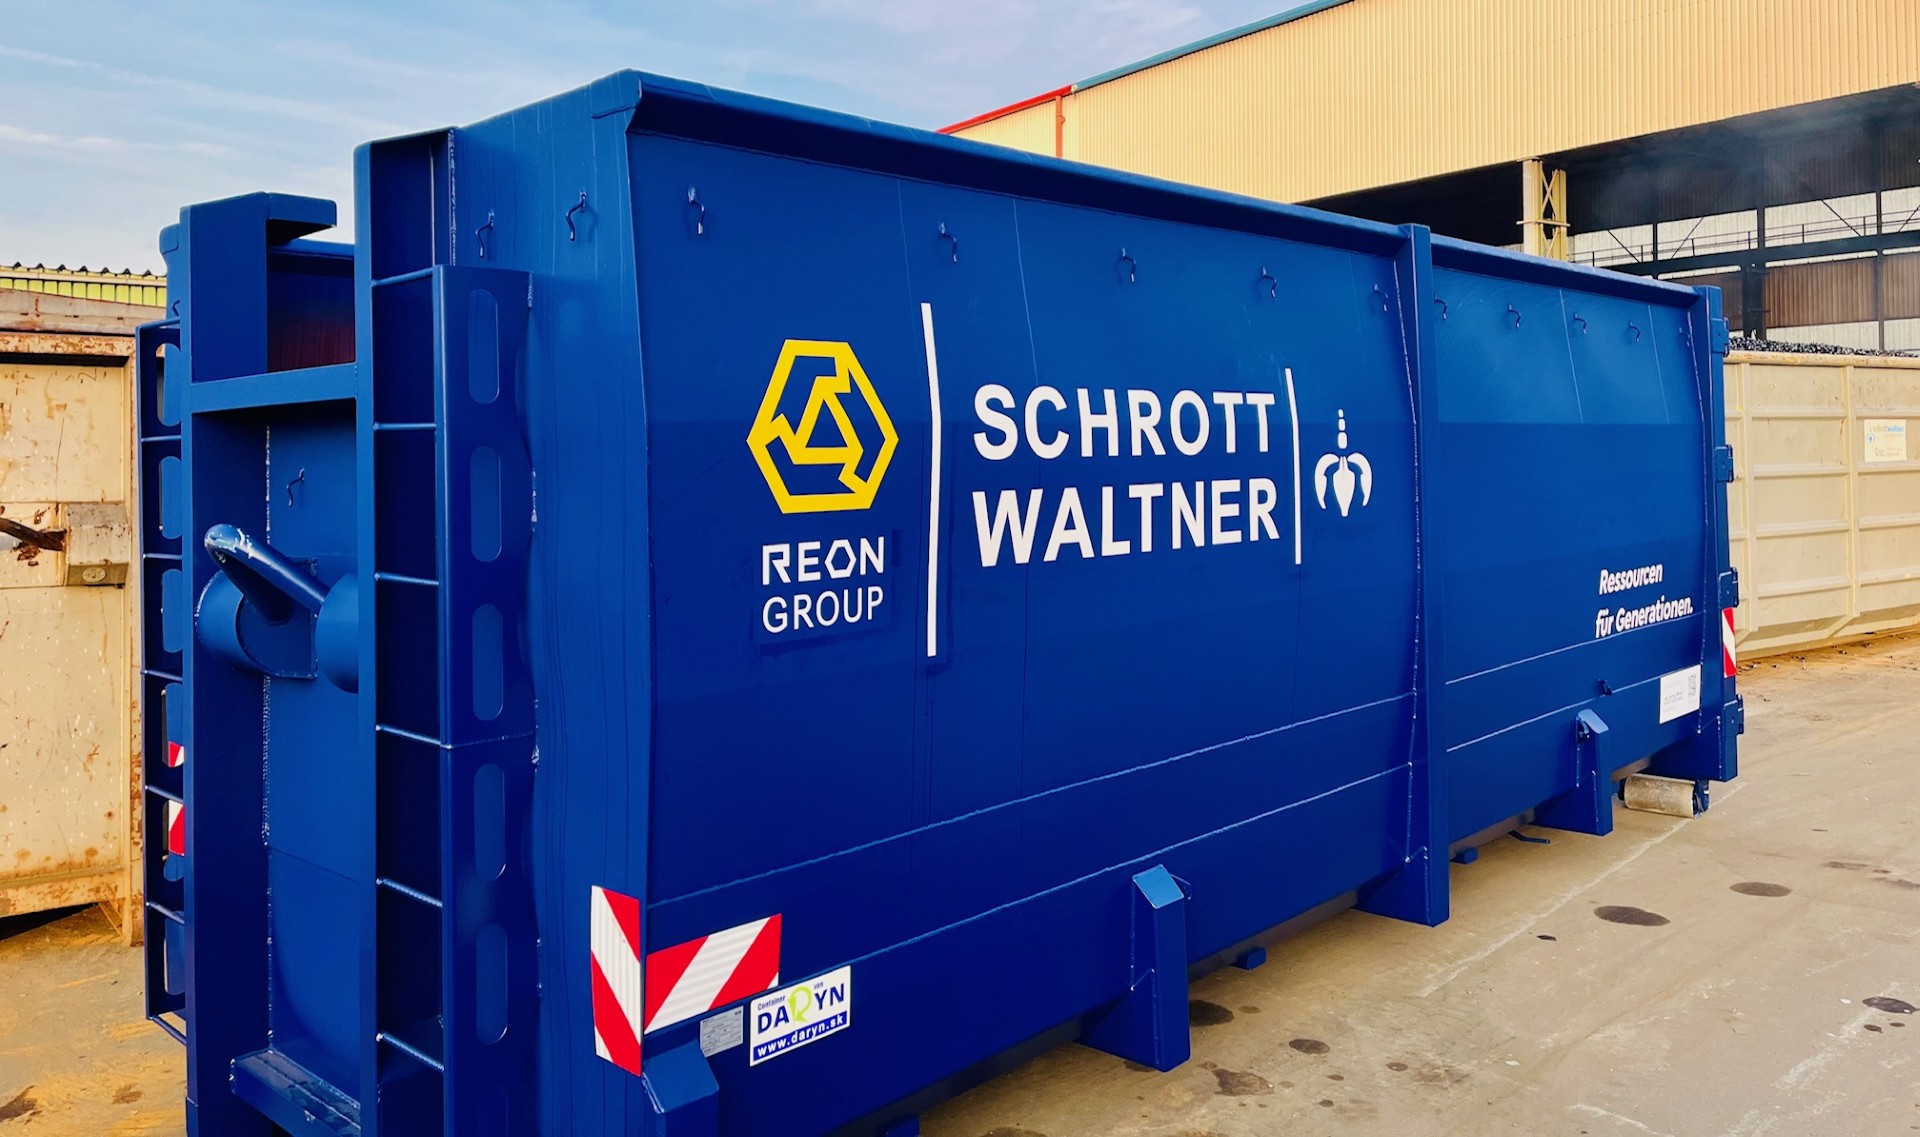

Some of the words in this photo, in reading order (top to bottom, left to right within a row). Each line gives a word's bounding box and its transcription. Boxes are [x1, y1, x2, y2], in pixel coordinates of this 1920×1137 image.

[973, 384, 1275, 460] SCHROTT
[972, 478, 1280, 567] WALTNER
[762, 536, 885, 585] REON
[1599, 563, 1663, 595] Ressourcen
[762, 585, 884, 633] GROUP
[1595, 608, 1614, 639] für
[1615, 594, 1693, 632] Generationen.
[757, 995, 786, 1011] Container
[757, 982, 845, 1034] DARYN
[757, 1014, 844, 1058] www.daryn.sk
